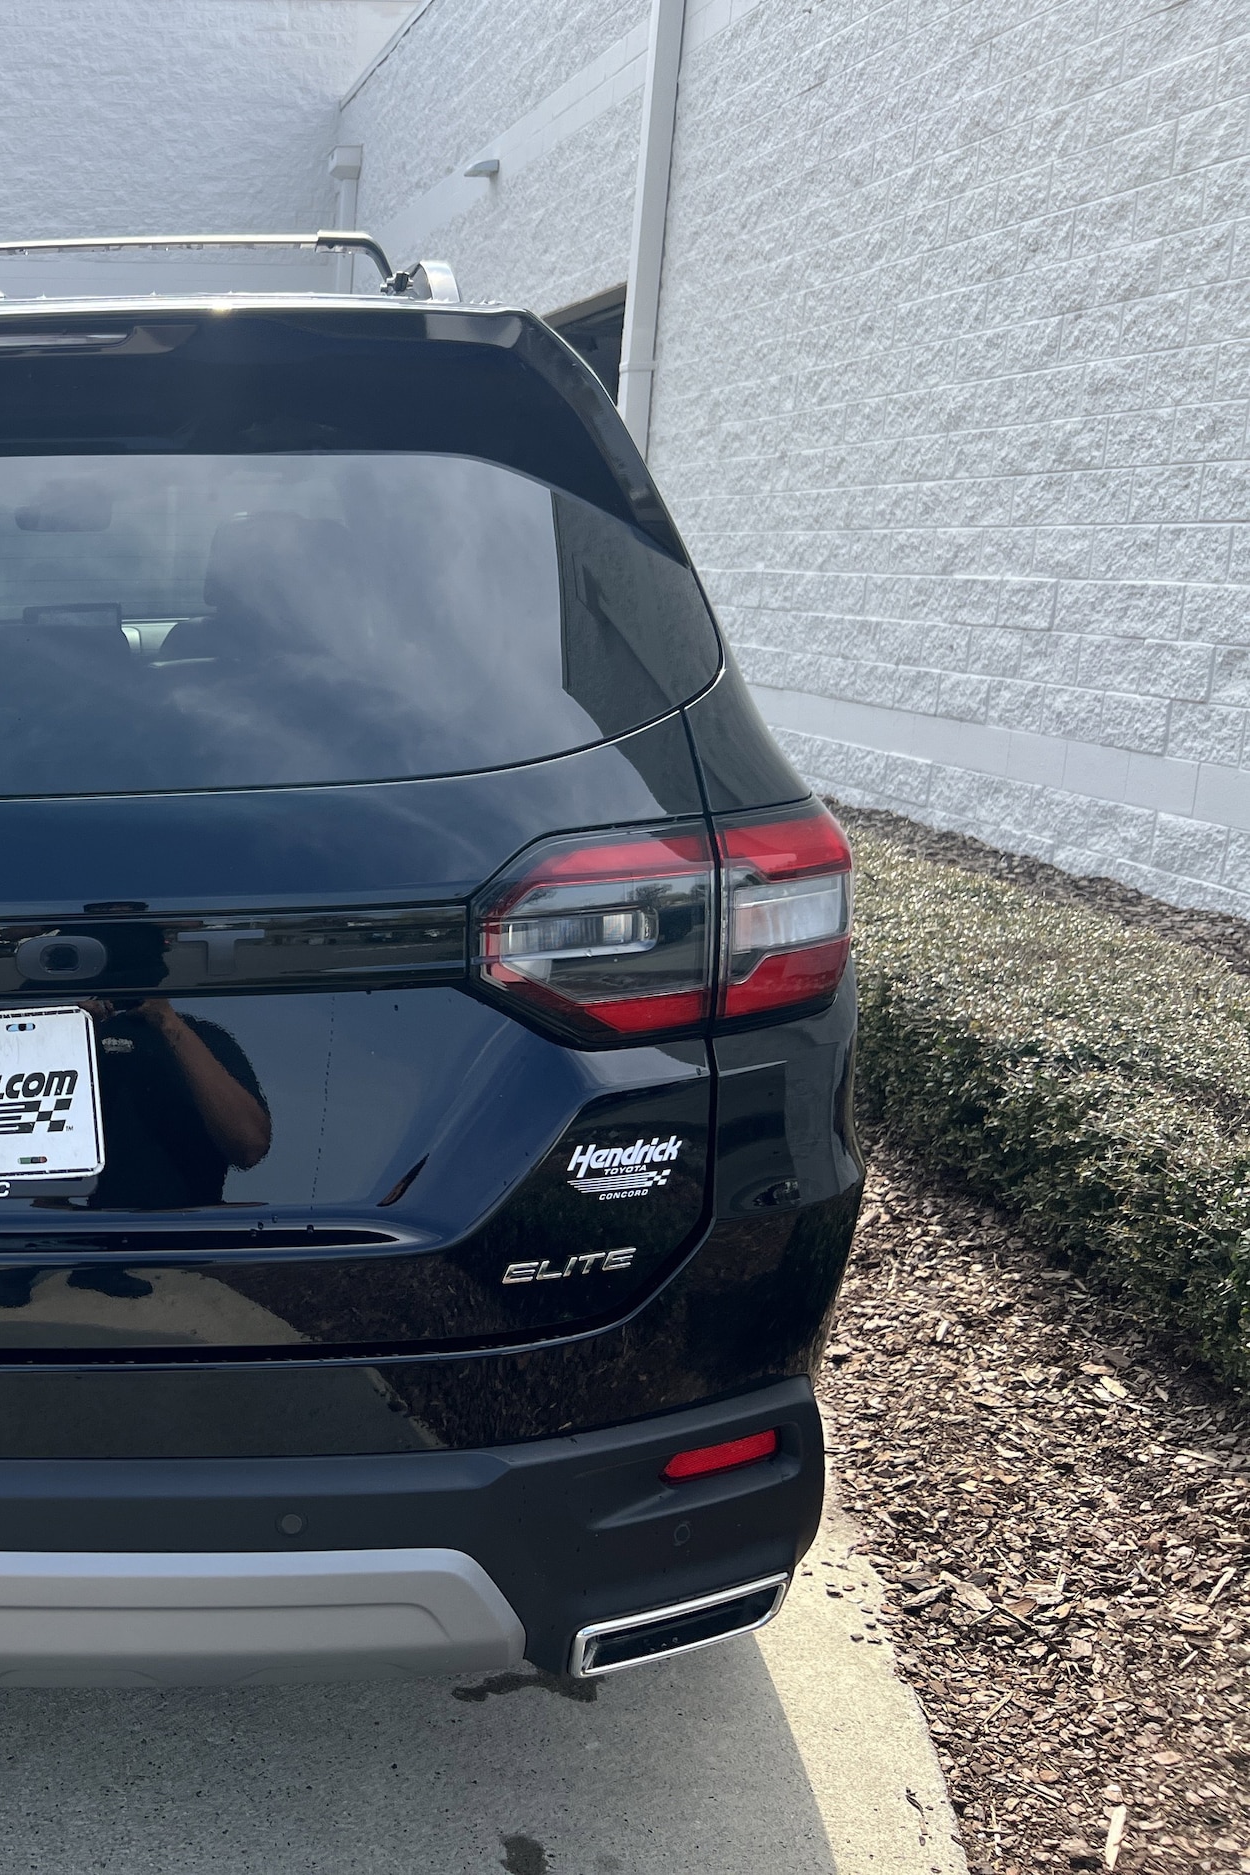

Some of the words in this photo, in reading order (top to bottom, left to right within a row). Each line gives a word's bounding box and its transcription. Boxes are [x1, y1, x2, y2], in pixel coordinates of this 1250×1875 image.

[566, 1135, 683, 1178] Hendrick
[603, 1164, 648, 1176] TOYOTA
[598, 1188, 649, 1201] CONCORD
[501, 1246, 638, 1285] ELITE
